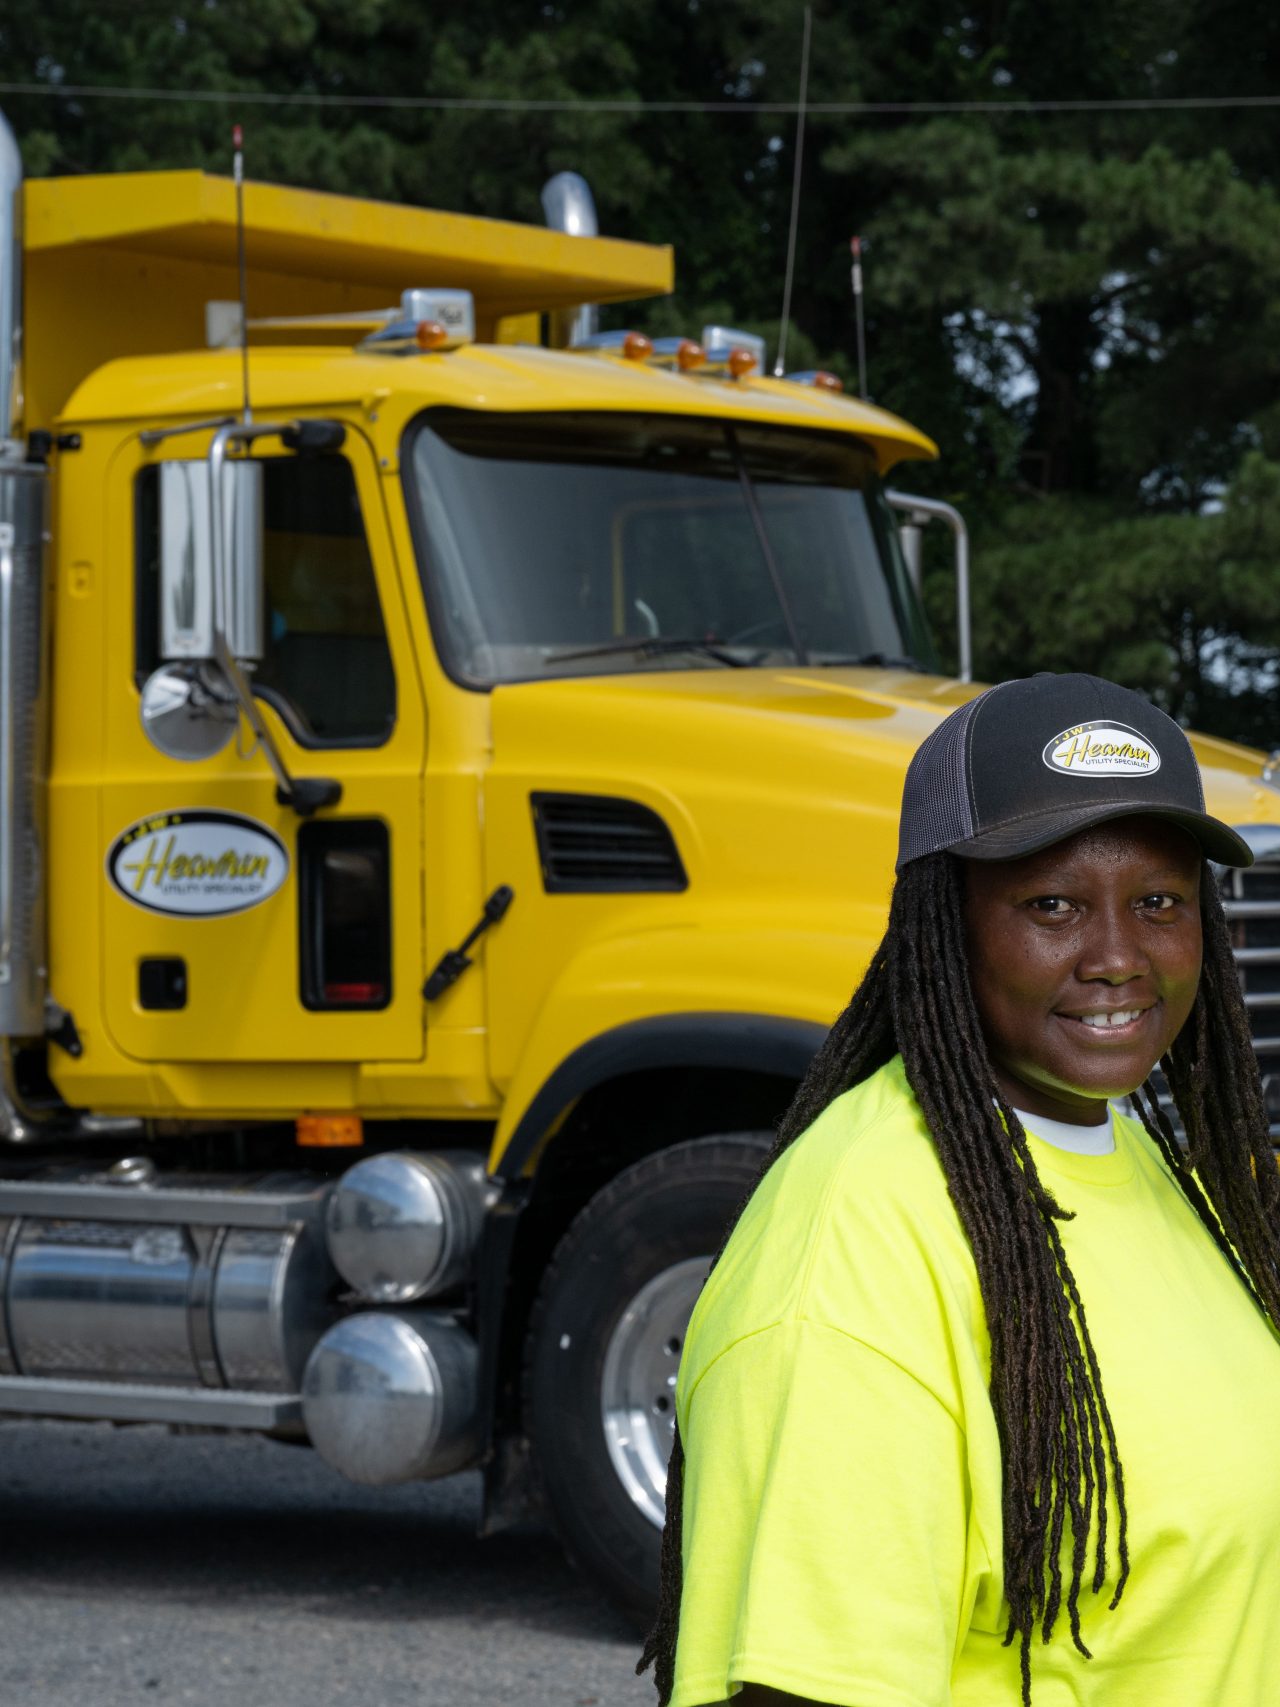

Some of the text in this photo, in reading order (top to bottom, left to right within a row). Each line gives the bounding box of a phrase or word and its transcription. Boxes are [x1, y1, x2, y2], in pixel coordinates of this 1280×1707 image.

[1062, 726, 1083, 741] JW
[1086, 758, 1150, 769] UTILITY SPECIALIST
